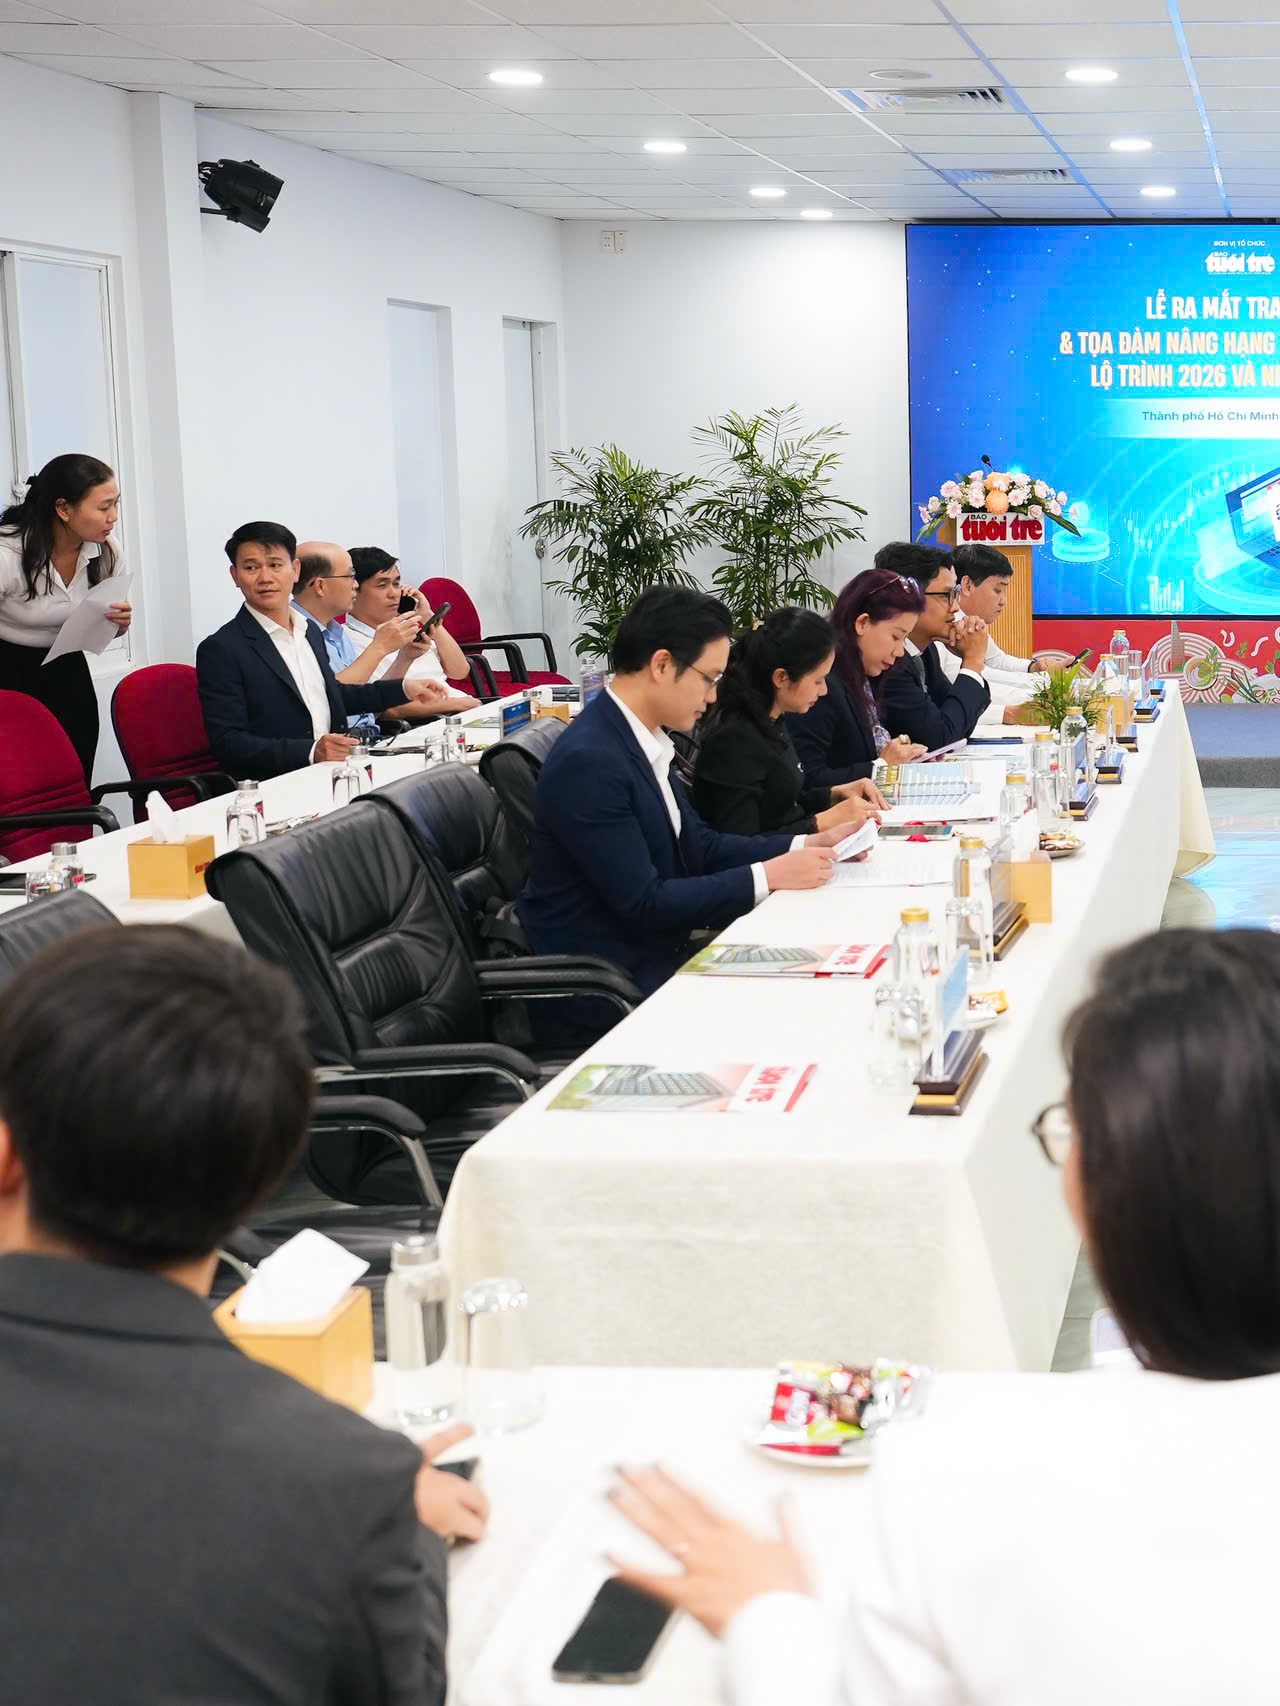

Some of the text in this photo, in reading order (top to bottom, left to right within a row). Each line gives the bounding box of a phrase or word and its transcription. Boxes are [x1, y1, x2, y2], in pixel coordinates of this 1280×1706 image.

[1145, 288, 1167, 320] LỄ
[1171, 296, 1198, 320] RA
[1202, 288, 1242, 320] MẮT
[1059, 331, 1074, 355] &
[1077, 331, 1114, 358] TỌA
[1119, 327, 1161, 355] ĐÀM
[1166, 327, 1218, 355] NÂNG
[1223, 331, 1275, 358] HẠNG
[1090, 359, 1113, 390] LỘ
[1117, 359, 1174, 388] TRÌNH
[1178, 364, 1226, 388] 2026
[1231, 359, 1257, 388] VÀ
[1141, 411, 1179, 421] Thành
[1182, 411, 1205, 422] phố
[1207, 411, 1224, 421] Hồ
[1227, 411, 1247, 421] Chí
